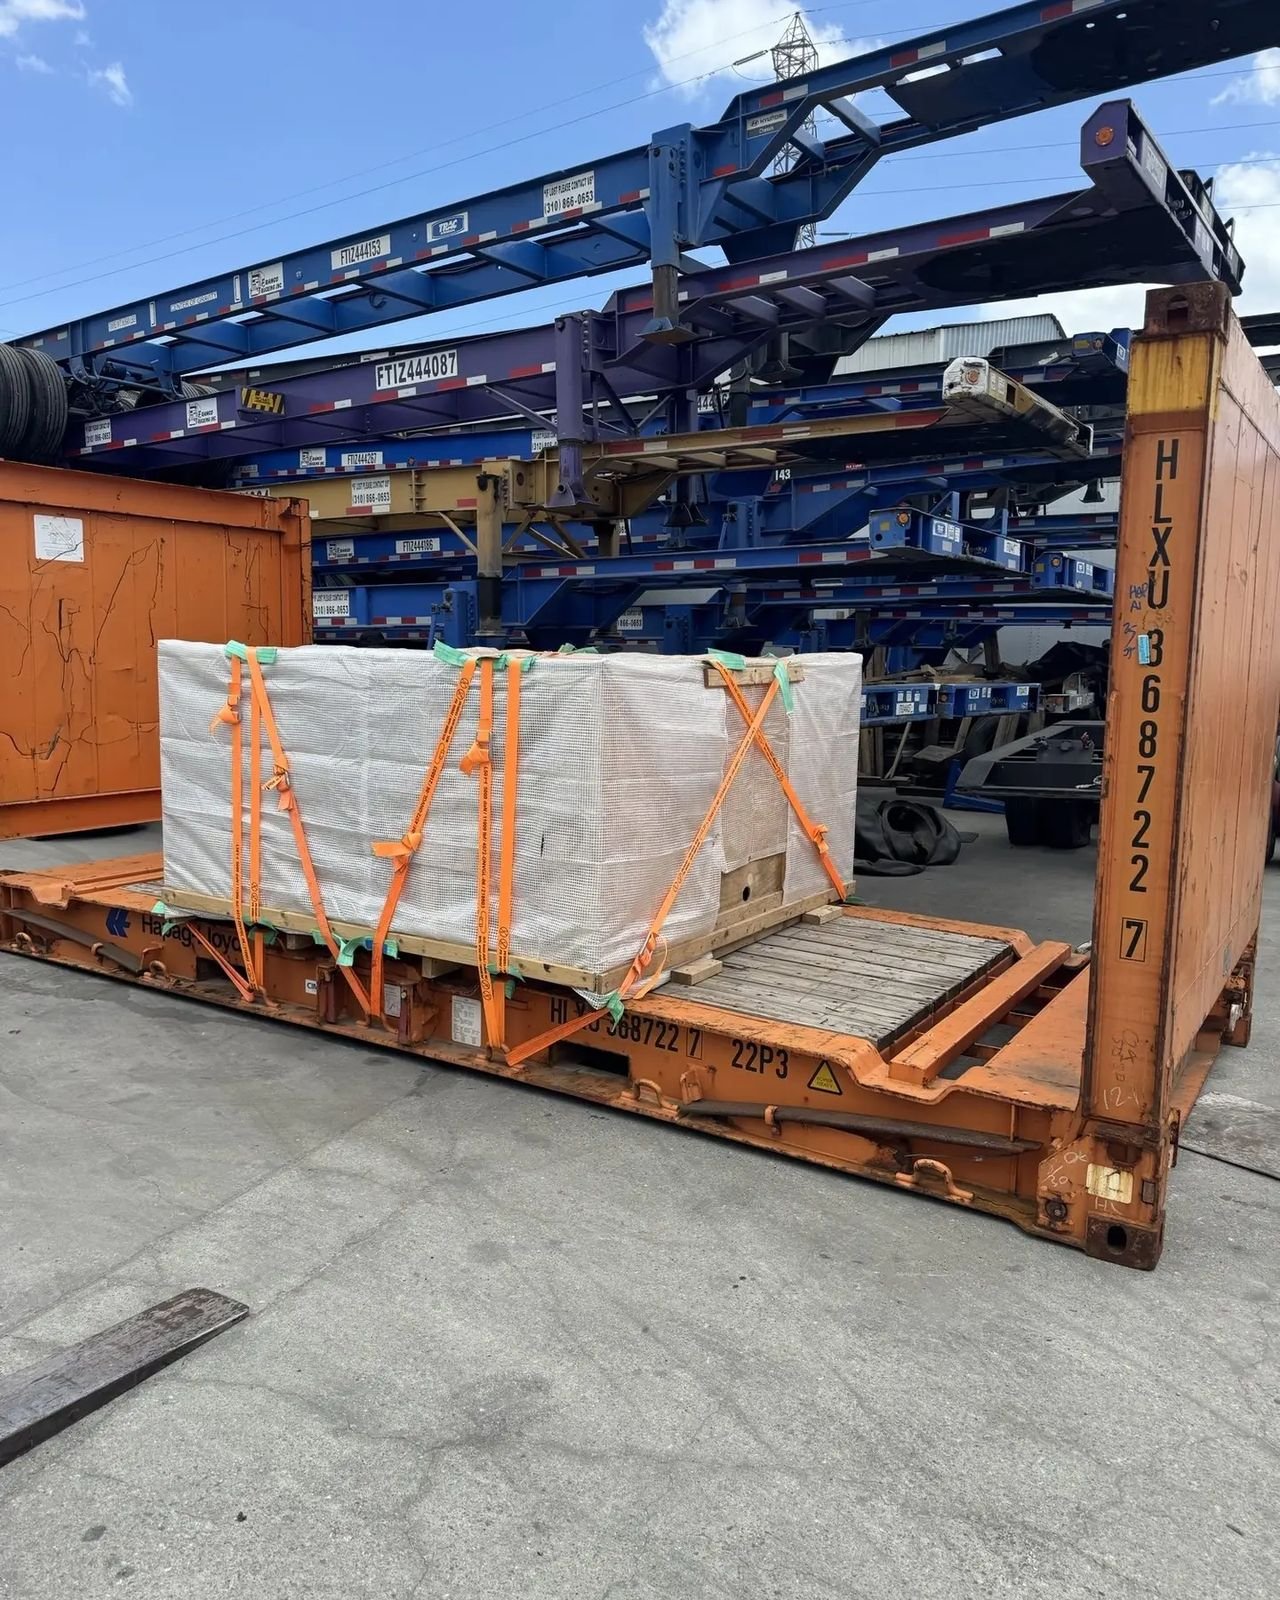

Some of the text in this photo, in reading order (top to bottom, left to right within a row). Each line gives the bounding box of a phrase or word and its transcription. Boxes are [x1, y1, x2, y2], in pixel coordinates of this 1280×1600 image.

[544, 190, 594, 215] (310) 866-0653
[438, 219, 458, 233] TRAC
[340, 239, 381, 265] FTIZ444153
[376, 352, 456, 387] FTIZ444087
[775, 468, 791, 481] 143
[1146, 438, 1179, 610] HLXU
[1129, 628, 1164, 893] 368722
[1125, 920, 1144, 958] 7
[689, 1027, 701, 1057] 7
[731, 1038, 789, 1079] 22P3
